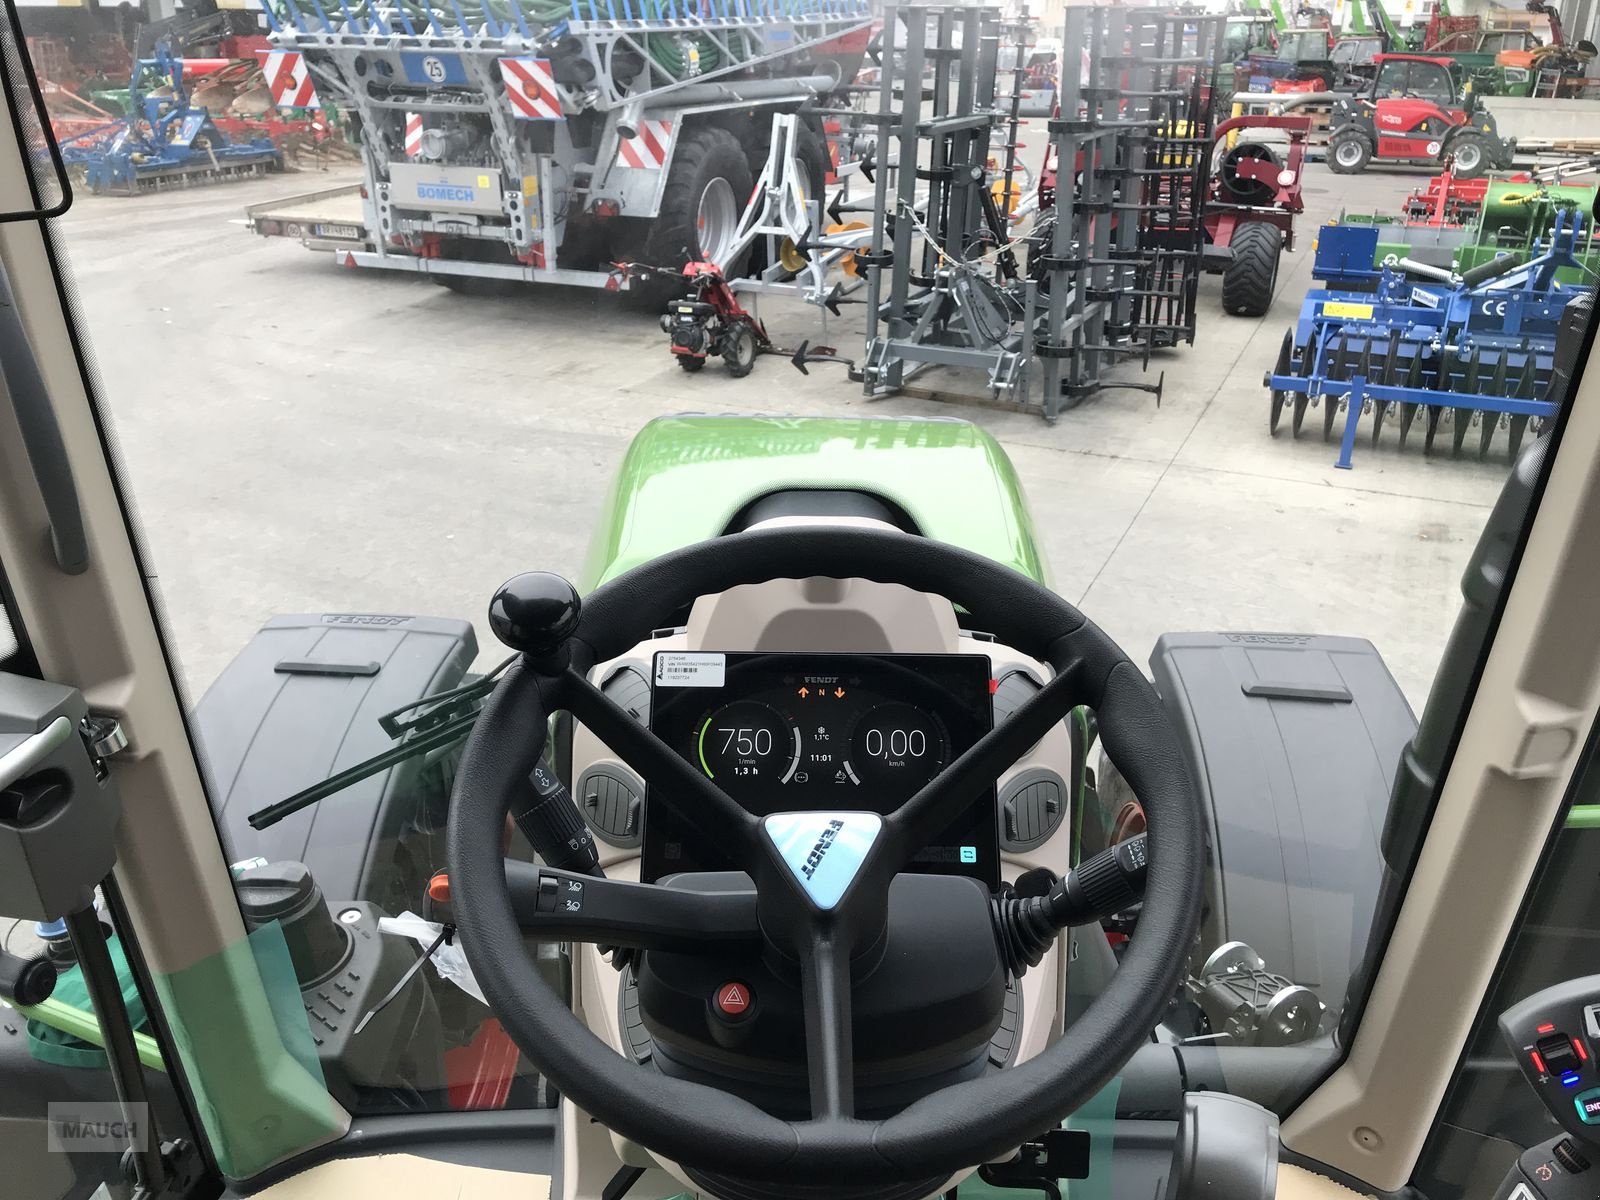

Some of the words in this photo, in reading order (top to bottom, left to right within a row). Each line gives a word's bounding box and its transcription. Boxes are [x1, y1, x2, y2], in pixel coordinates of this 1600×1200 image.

[426, 61, 442, 77] 25
[417, 186, 474, 201] BOMECH
[325, 615, 412, 626] FENDT
[804, 676, 839, 684] FENDT
[818, 688, 825, 696] N
[717, 728, 772, 756] 750
[866, 729, 926, 760] 0,00
[810, 754, 832, 762] 11:01
[734, 767, 749, 776] 1,3
[752, 767, 759, 775] h
[800, 819, 845, 881] FENDT
